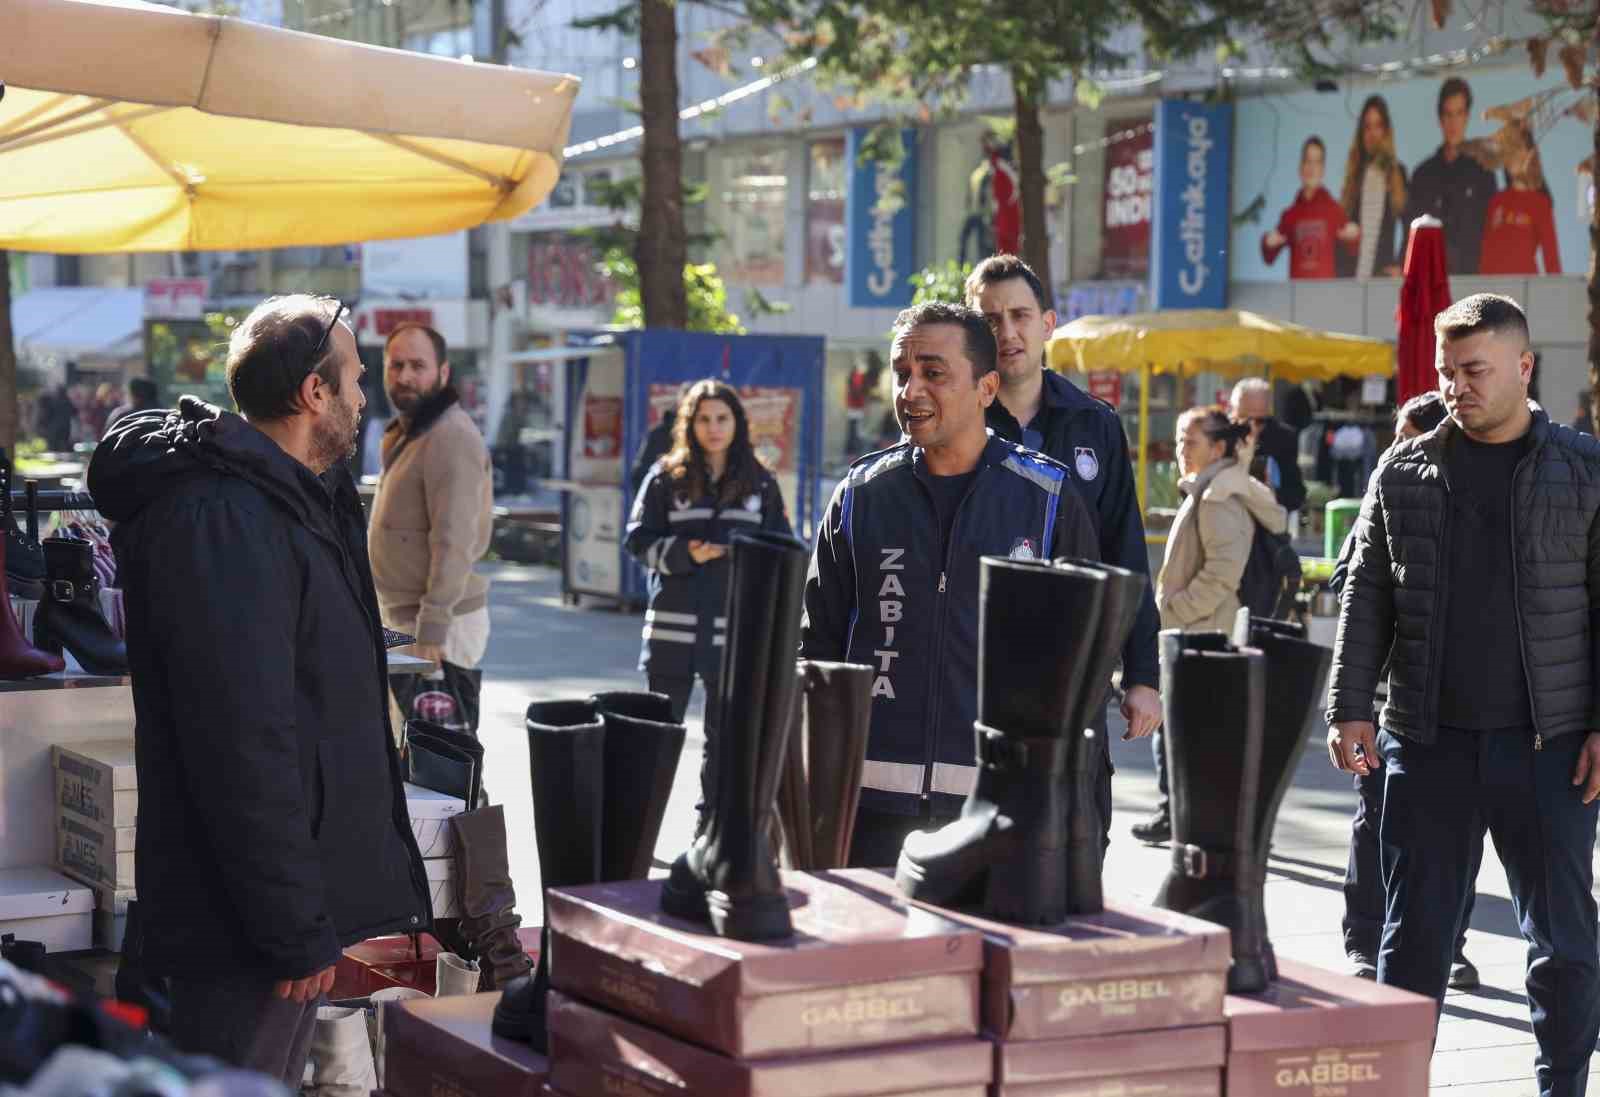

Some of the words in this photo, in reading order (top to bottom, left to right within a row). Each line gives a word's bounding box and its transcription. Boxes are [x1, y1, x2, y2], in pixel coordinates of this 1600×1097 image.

[871, 548, 906, 699] ZABITA
[1059, 979, 1169, 1008] GABBEL
[801, 997, 925, 1025] GABBEL
[1276, 1063, 1382, 1088] GABBEL
